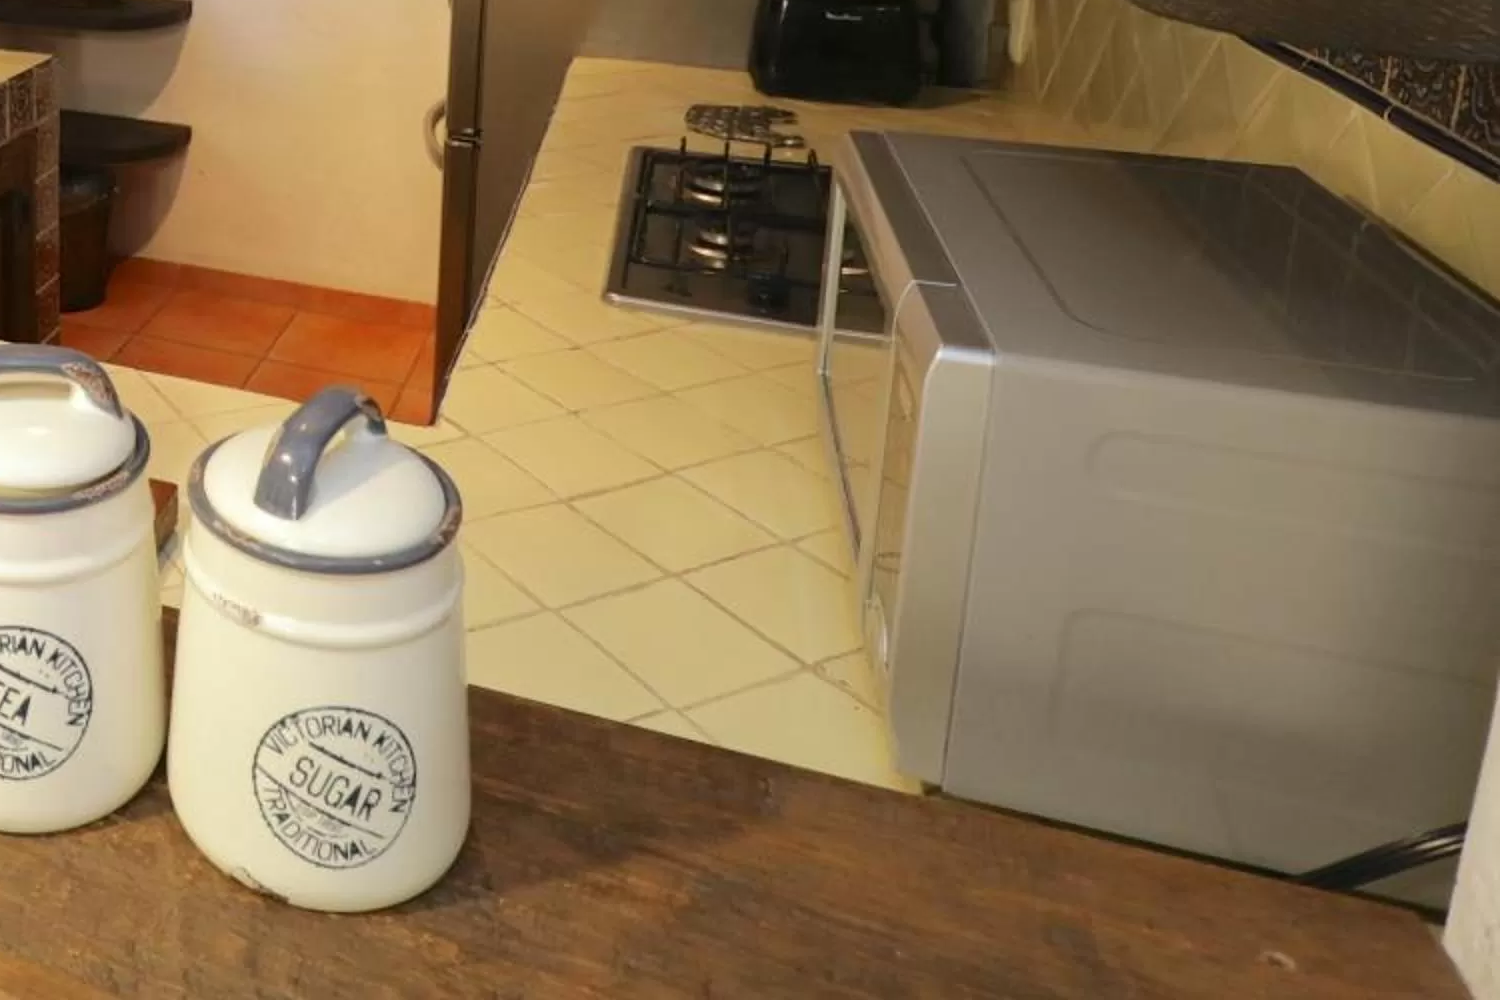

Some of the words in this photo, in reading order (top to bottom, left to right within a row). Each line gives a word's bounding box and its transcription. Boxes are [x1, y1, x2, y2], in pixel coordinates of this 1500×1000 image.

[46, 648, 88, 727] KITCHEN
[263, 715, 372, 756] VICTORIAN
[372, 730, 411, 813] KITCHEN
[289, 756, 383, 822] SUGAR
[263, 787, 377, 862] TRADITIONAL
